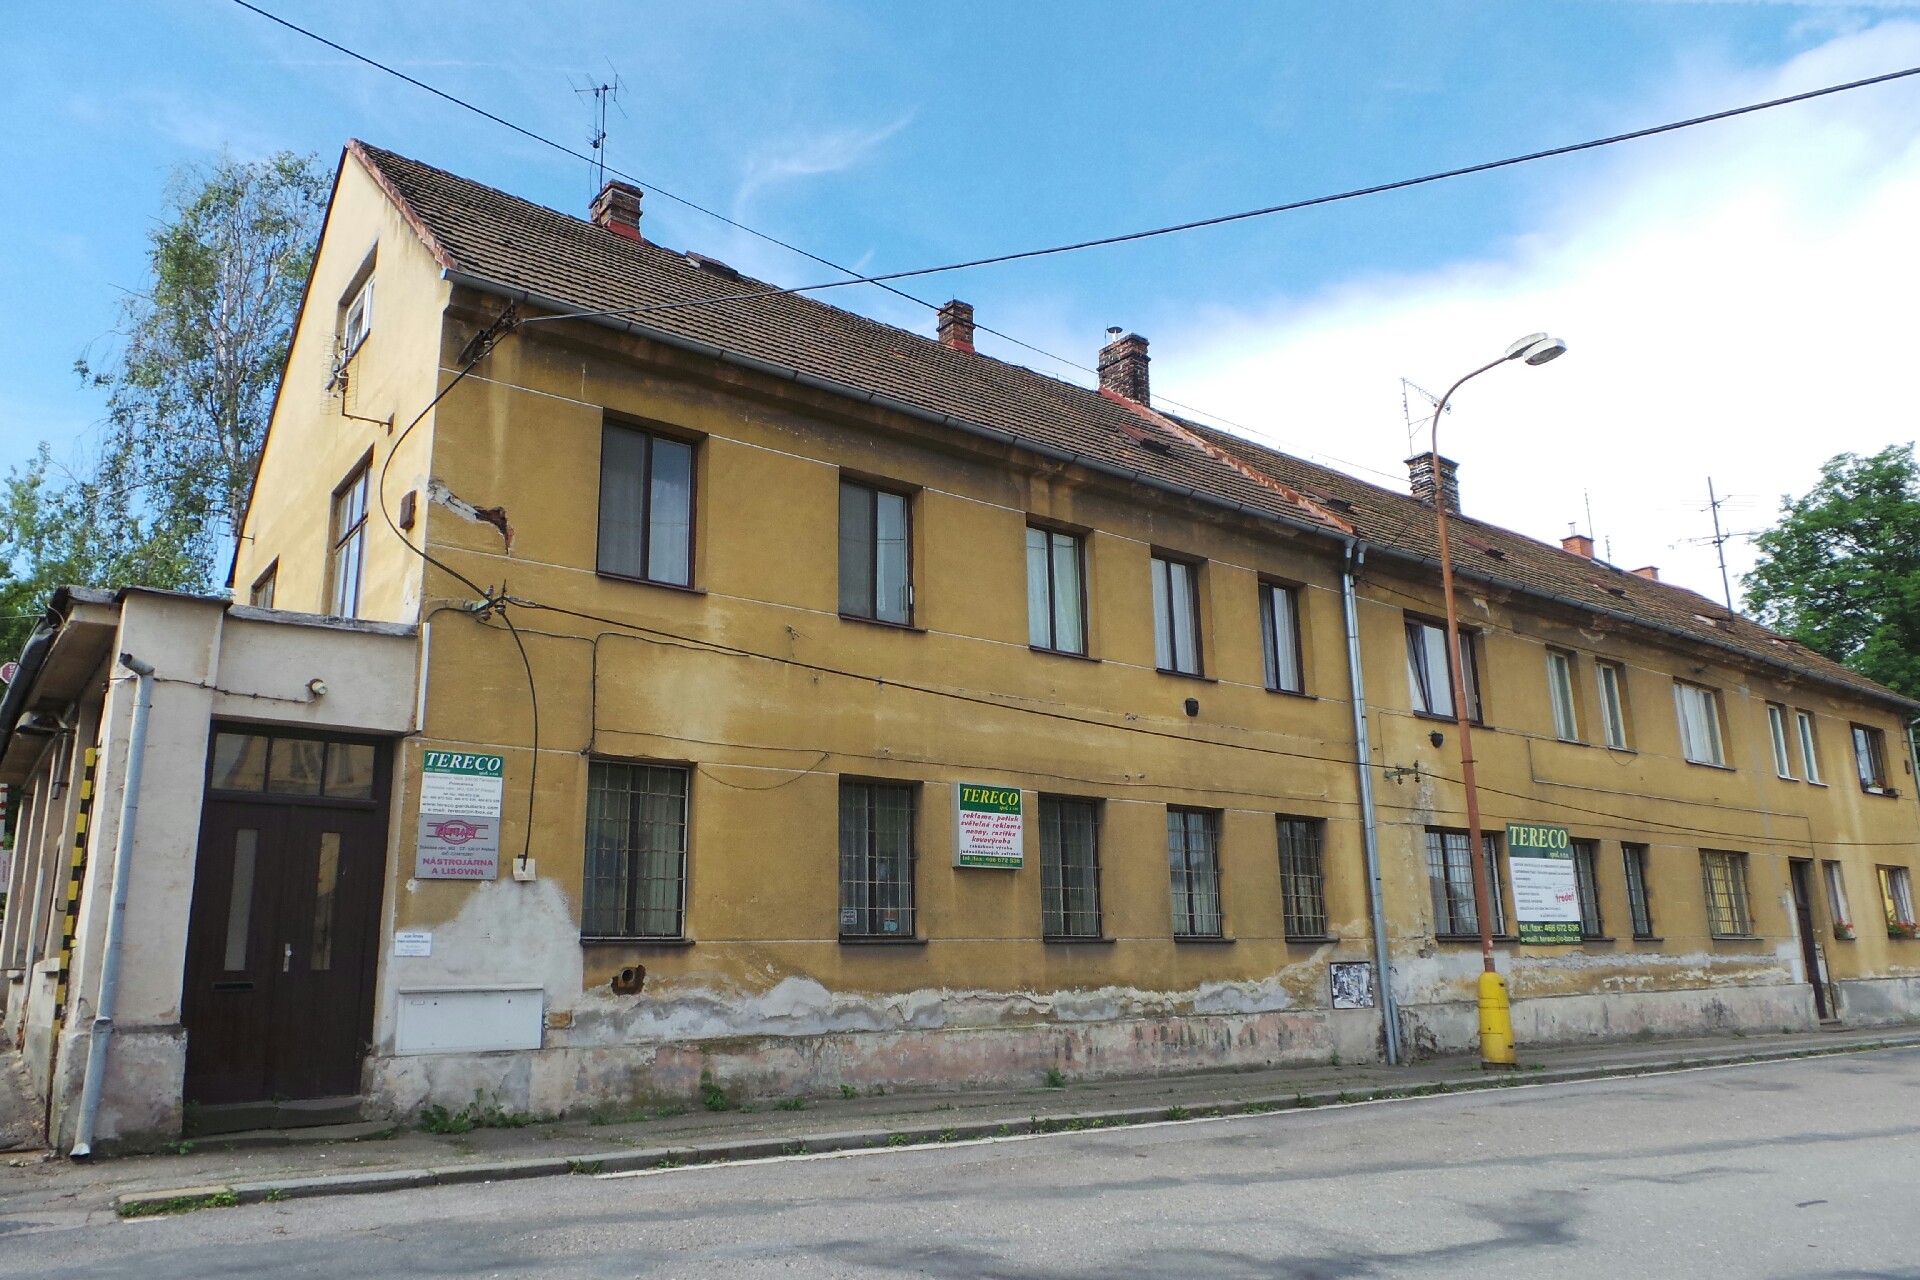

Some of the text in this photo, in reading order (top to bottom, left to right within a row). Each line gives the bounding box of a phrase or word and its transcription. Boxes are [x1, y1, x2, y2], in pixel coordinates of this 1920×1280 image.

[427, 752, 501, 772] TERECO
[963, 788, 1019, 806] TERECO
[962, 812, 994, 821] reklama,
[960, 820, 1021, 830] světelná reklama
[971, 836, 1011, 845] kovovýroba
[1509, 826, 1568, 849] TERECO
[422, 857, 494, 866] NÁSTROJÁRNA
